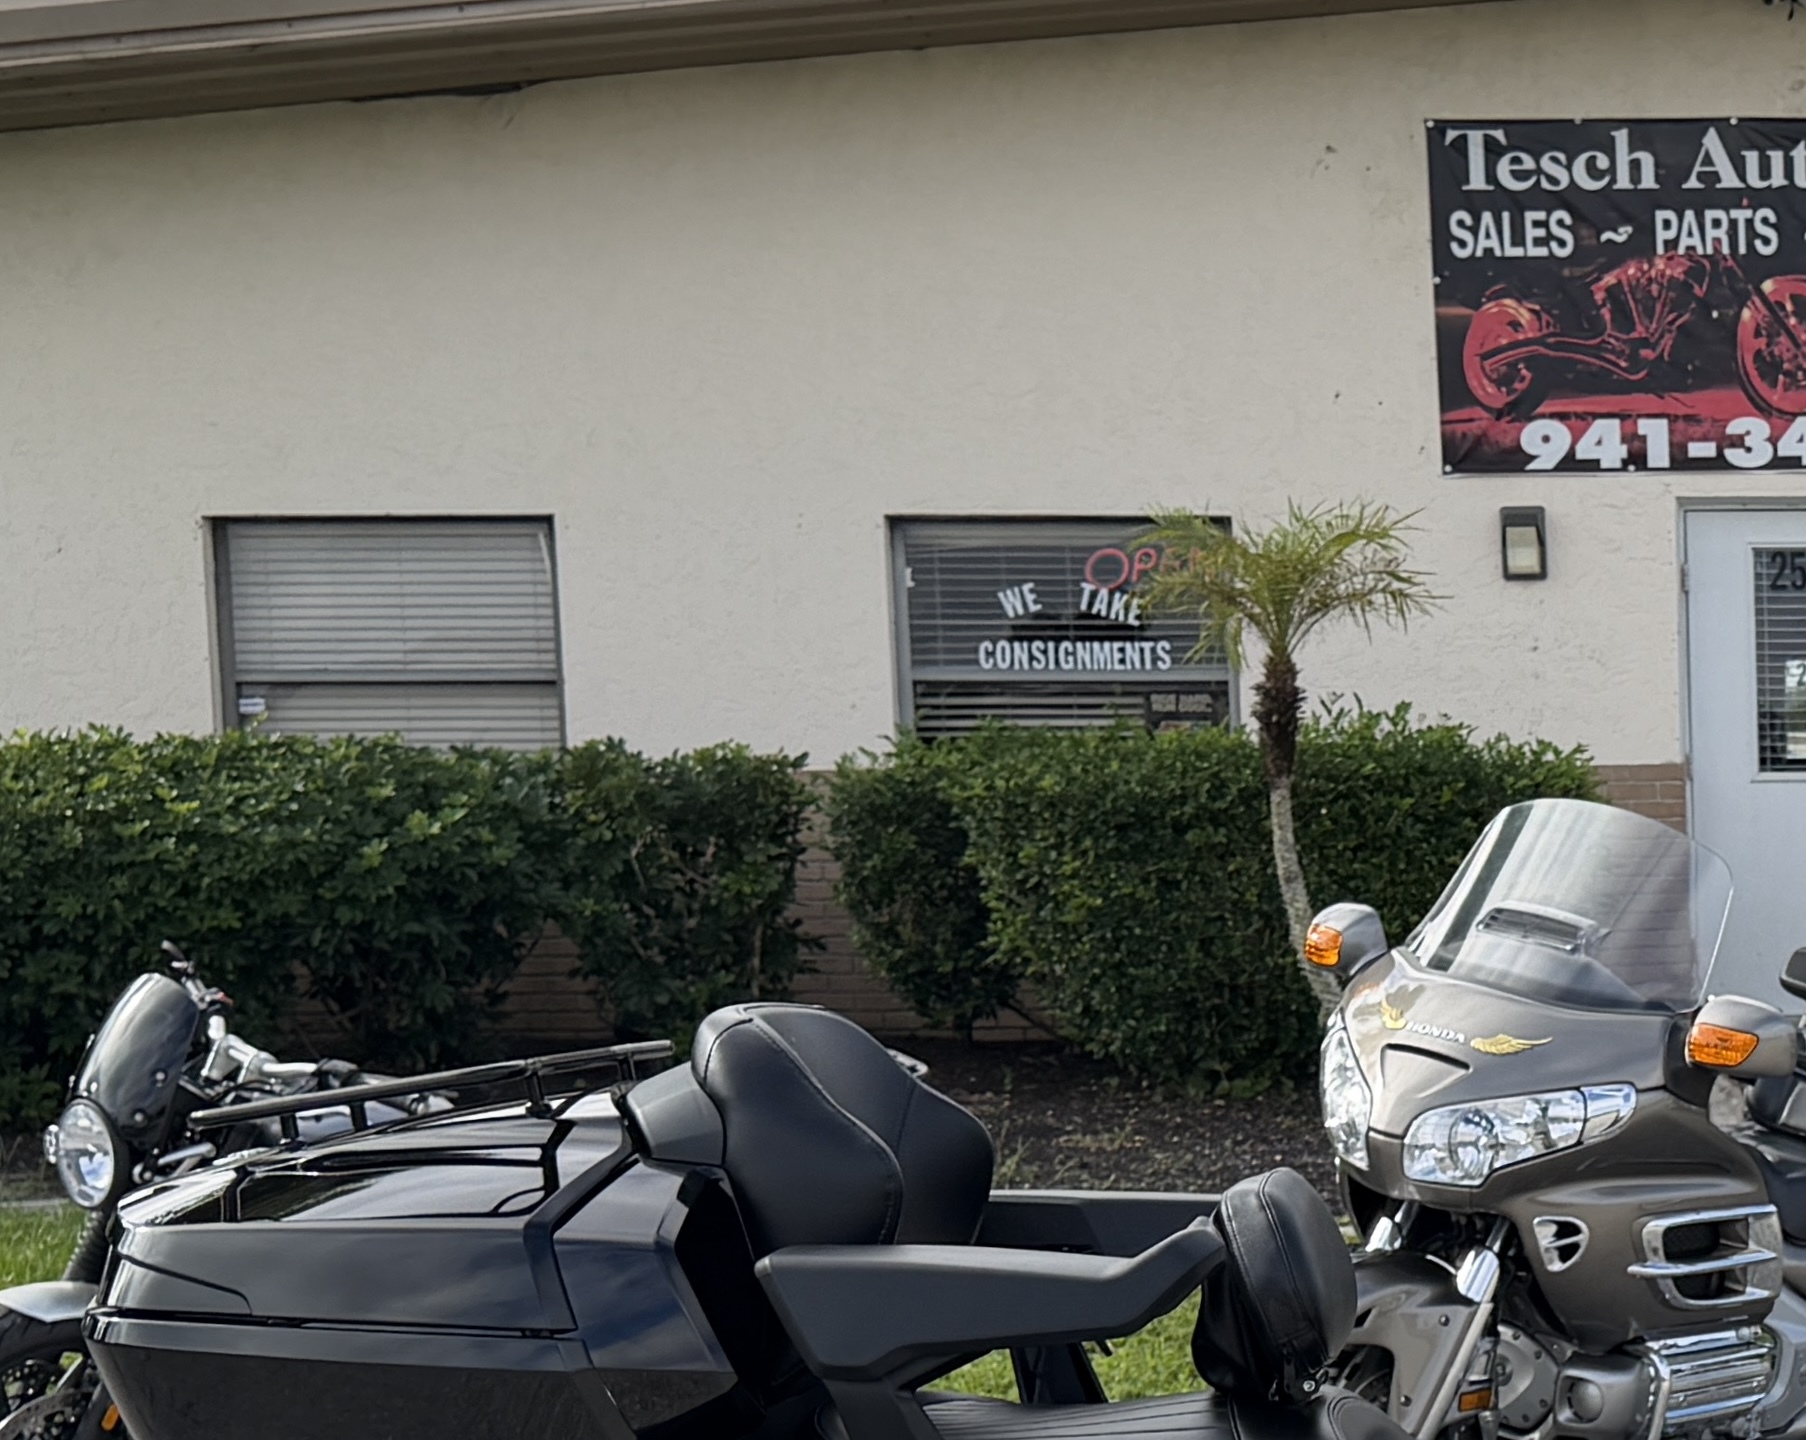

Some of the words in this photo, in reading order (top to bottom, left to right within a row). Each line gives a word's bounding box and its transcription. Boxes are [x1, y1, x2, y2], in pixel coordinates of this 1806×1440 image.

[1445, 127, 1660, 191] Tesch
[1449, 209, 1575, 258] SALES
[1654, 208, 1779, 256] PARTS
[998, 582, 1042, 619] WE
[1080, 582, 1141, 628] TAKE
[978, 640, 1172, 671] CONSIGNMENTS
[1405, 1020, 1465, 1043] HONDA
